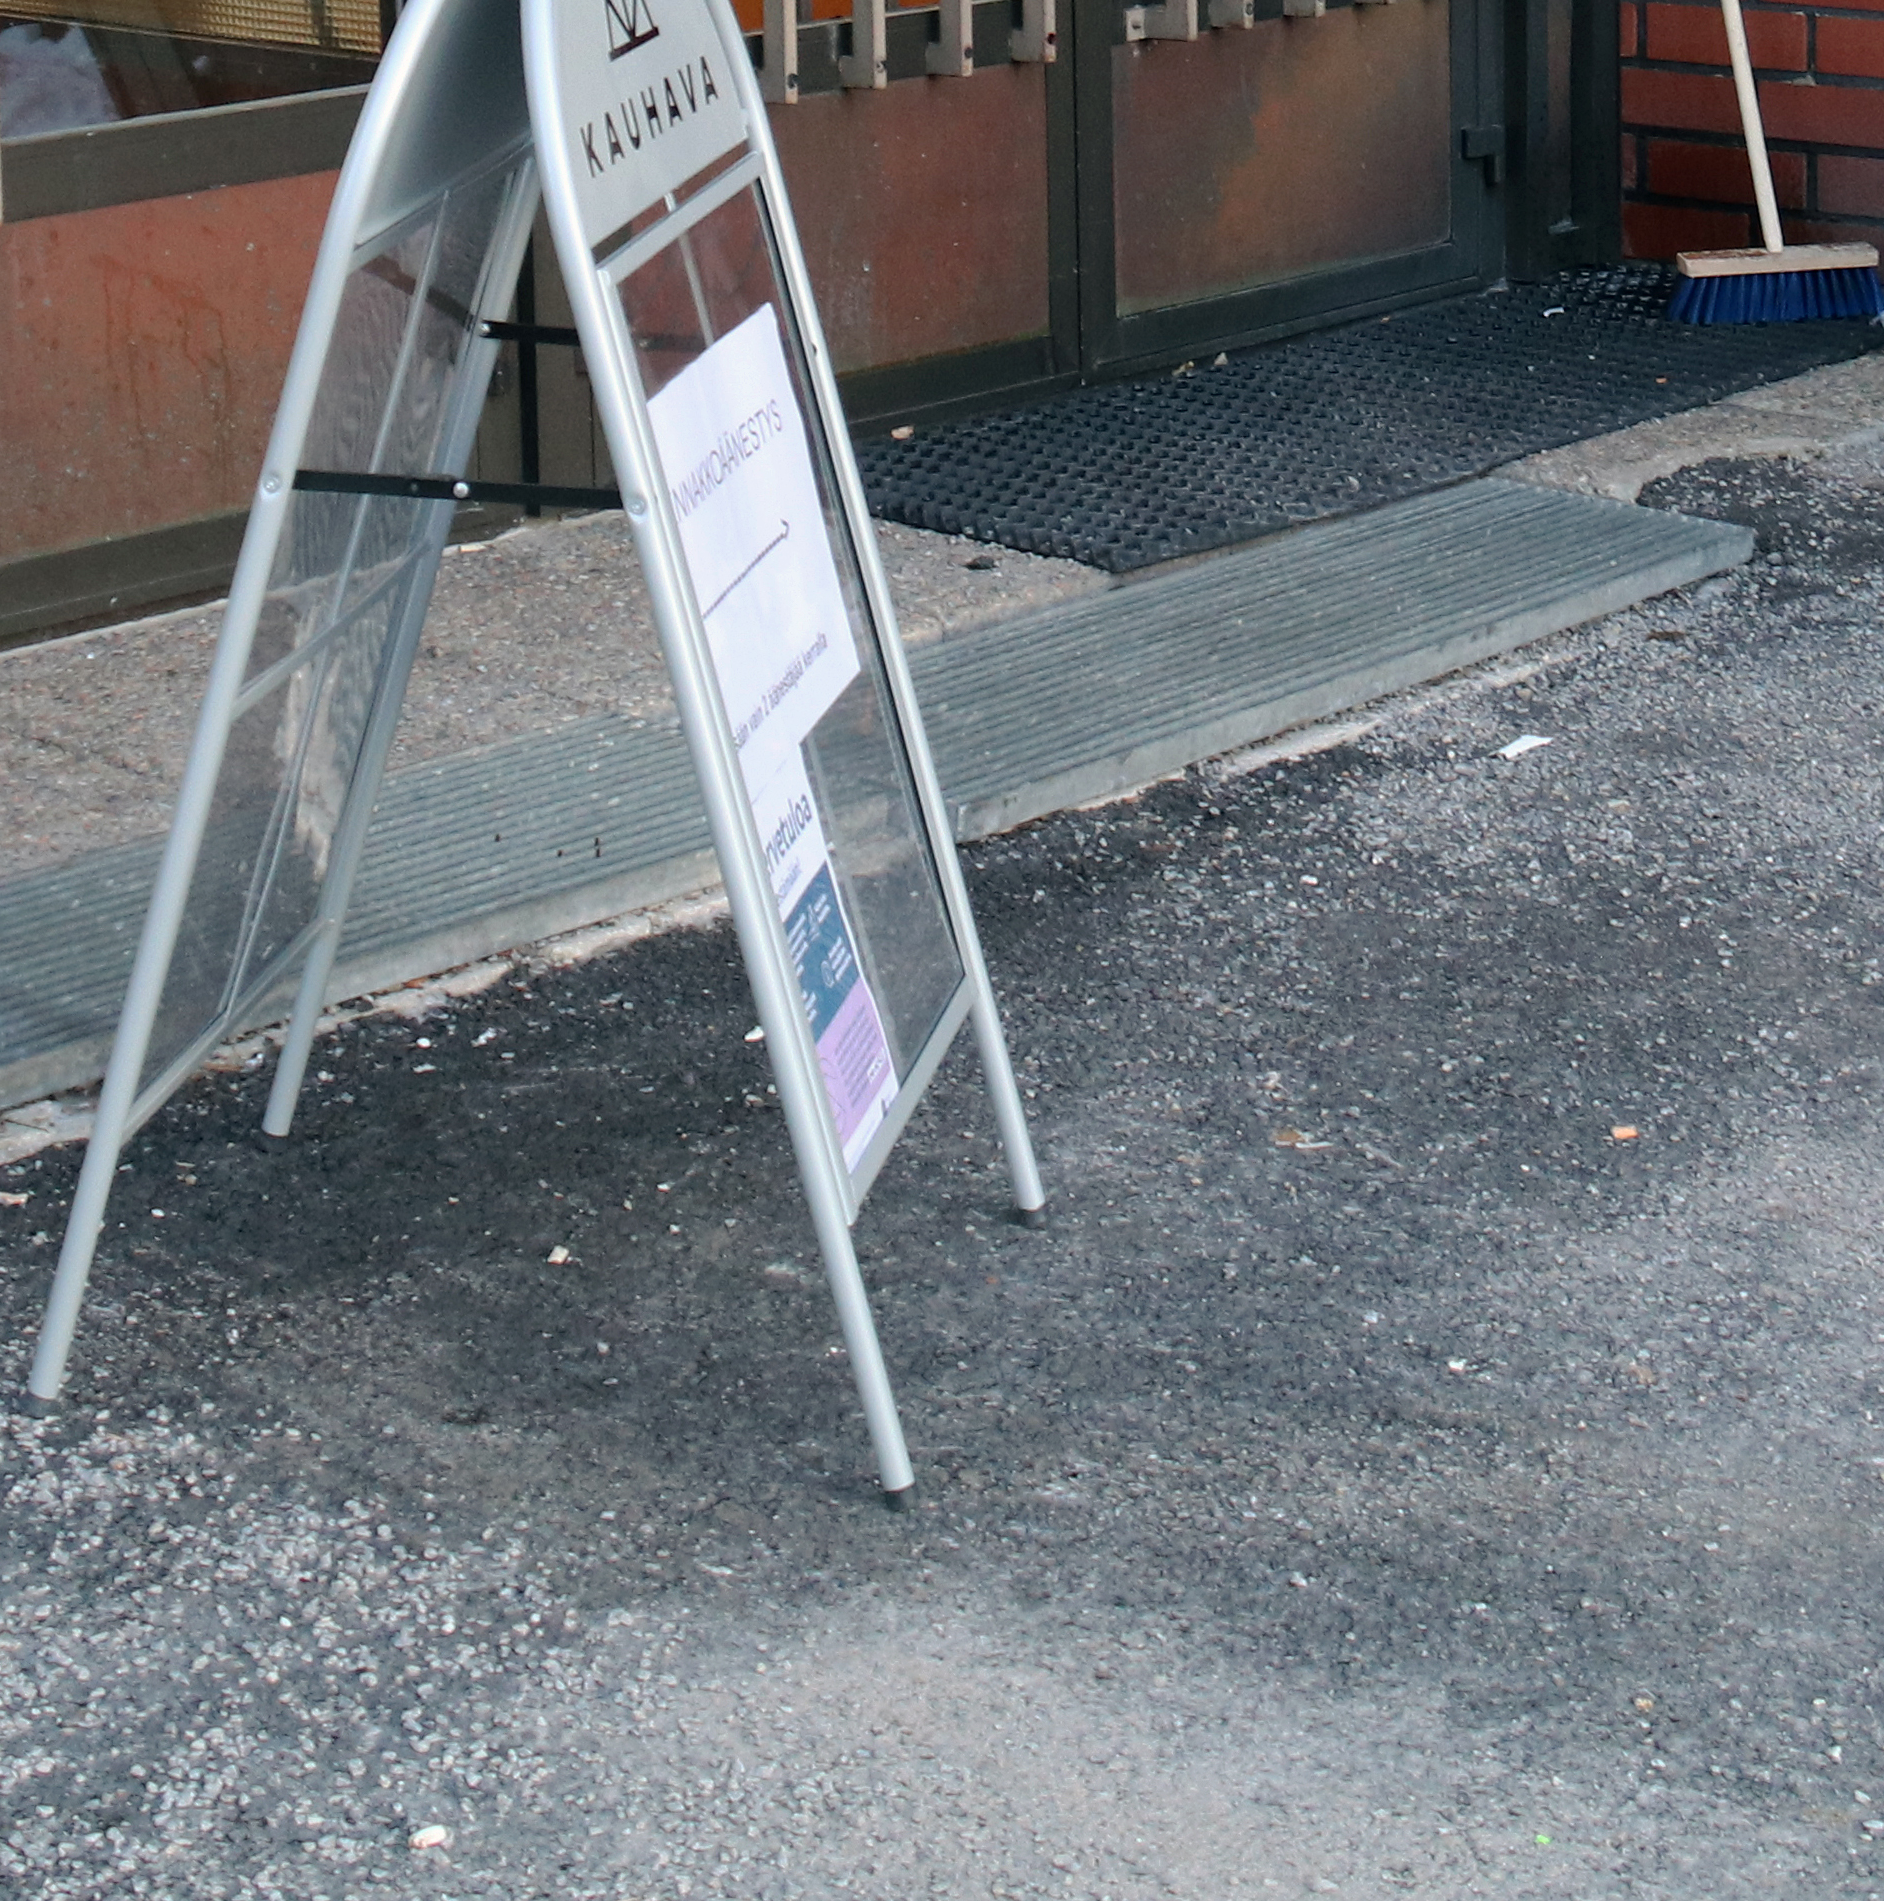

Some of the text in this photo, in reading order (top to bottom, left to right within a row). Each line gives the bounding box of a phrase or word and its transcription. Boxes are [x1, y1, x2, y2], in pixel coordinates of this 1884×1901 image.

[580, 56, 719, 178] KAUHAVA
[669, 398, 783, 522] NNAKKOÄÄNESTYS
[765, 794, 813, 875] rvetuloa
